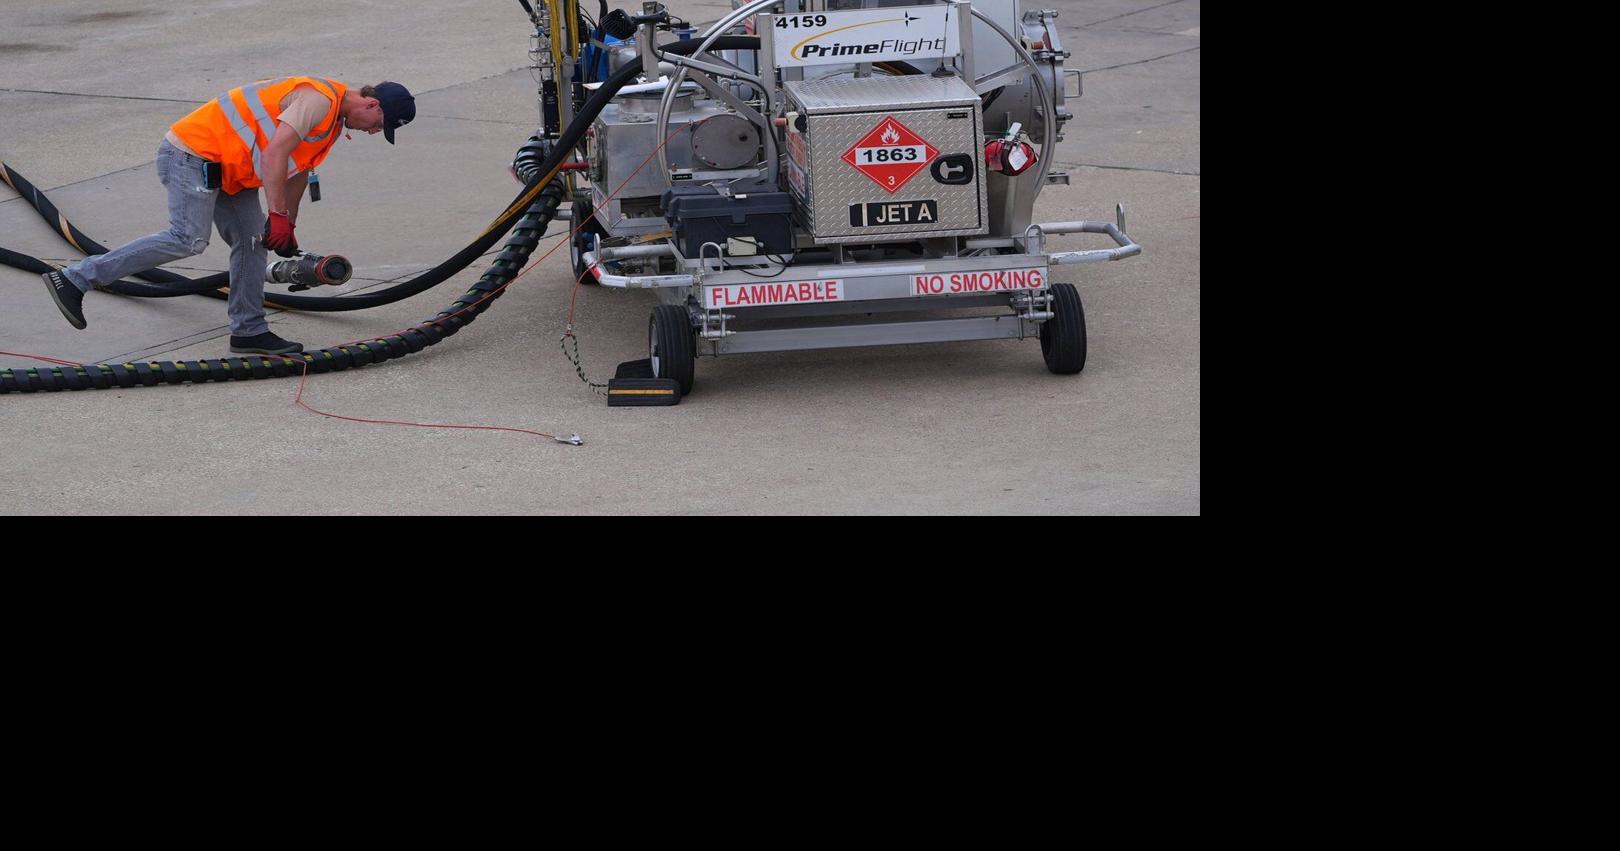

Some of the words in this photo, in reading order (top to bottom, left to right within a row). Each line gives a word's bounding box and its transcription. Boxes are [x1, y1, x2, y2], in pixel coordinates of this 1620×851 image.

[775, 14, 827, 29] 4159
[801, 37, 945, 58] PrimeFlight
[863, 147, 918, 163] 1863
[887, 175, 896, 186] 3
[876, 203, 913, 223] JET
[917, 202, 933, 221] A
[915, 275, 944, 295] NO
[950, 269, 1042, 292] SMOKING
[712, 280, 838, 306] FLAMMABLE
